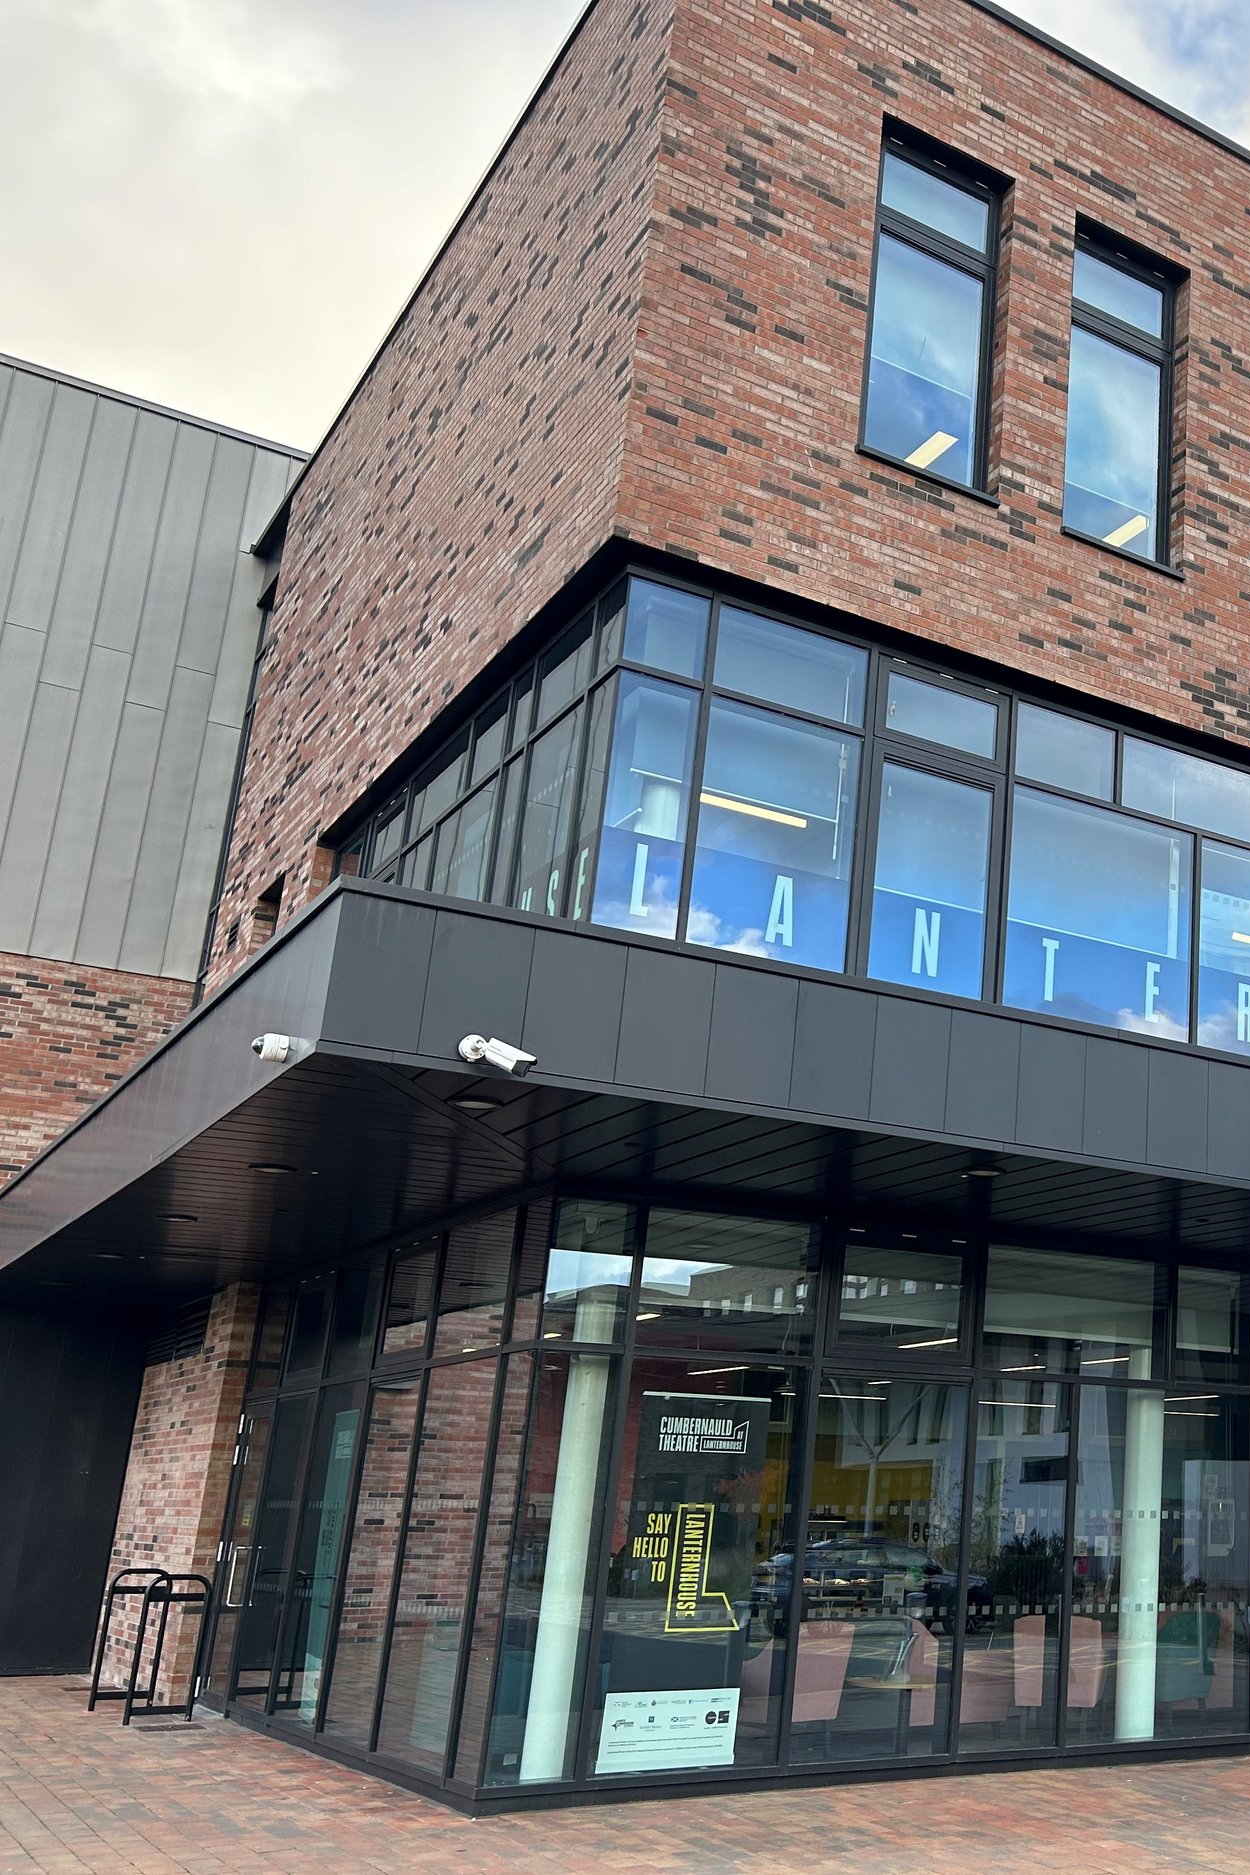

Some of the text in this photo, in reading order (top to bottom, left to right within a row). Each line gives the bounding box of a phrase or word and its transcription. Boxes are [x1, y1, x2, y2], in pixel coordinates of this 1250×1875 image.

[660, 1416, 733, 1436] CUMBERNAULD
[658, 1434, 700, 1452] THEATRE
[703, 1439, 743, 1450] LANTERNHOUSE
[646, 1513, 672, 1534] SAY
[632, 1536, 669, 1558] HELLO
[650, 1560, 666, 1582] TO
[675, 1513, 706, 1617] LANTERNHOUSE
